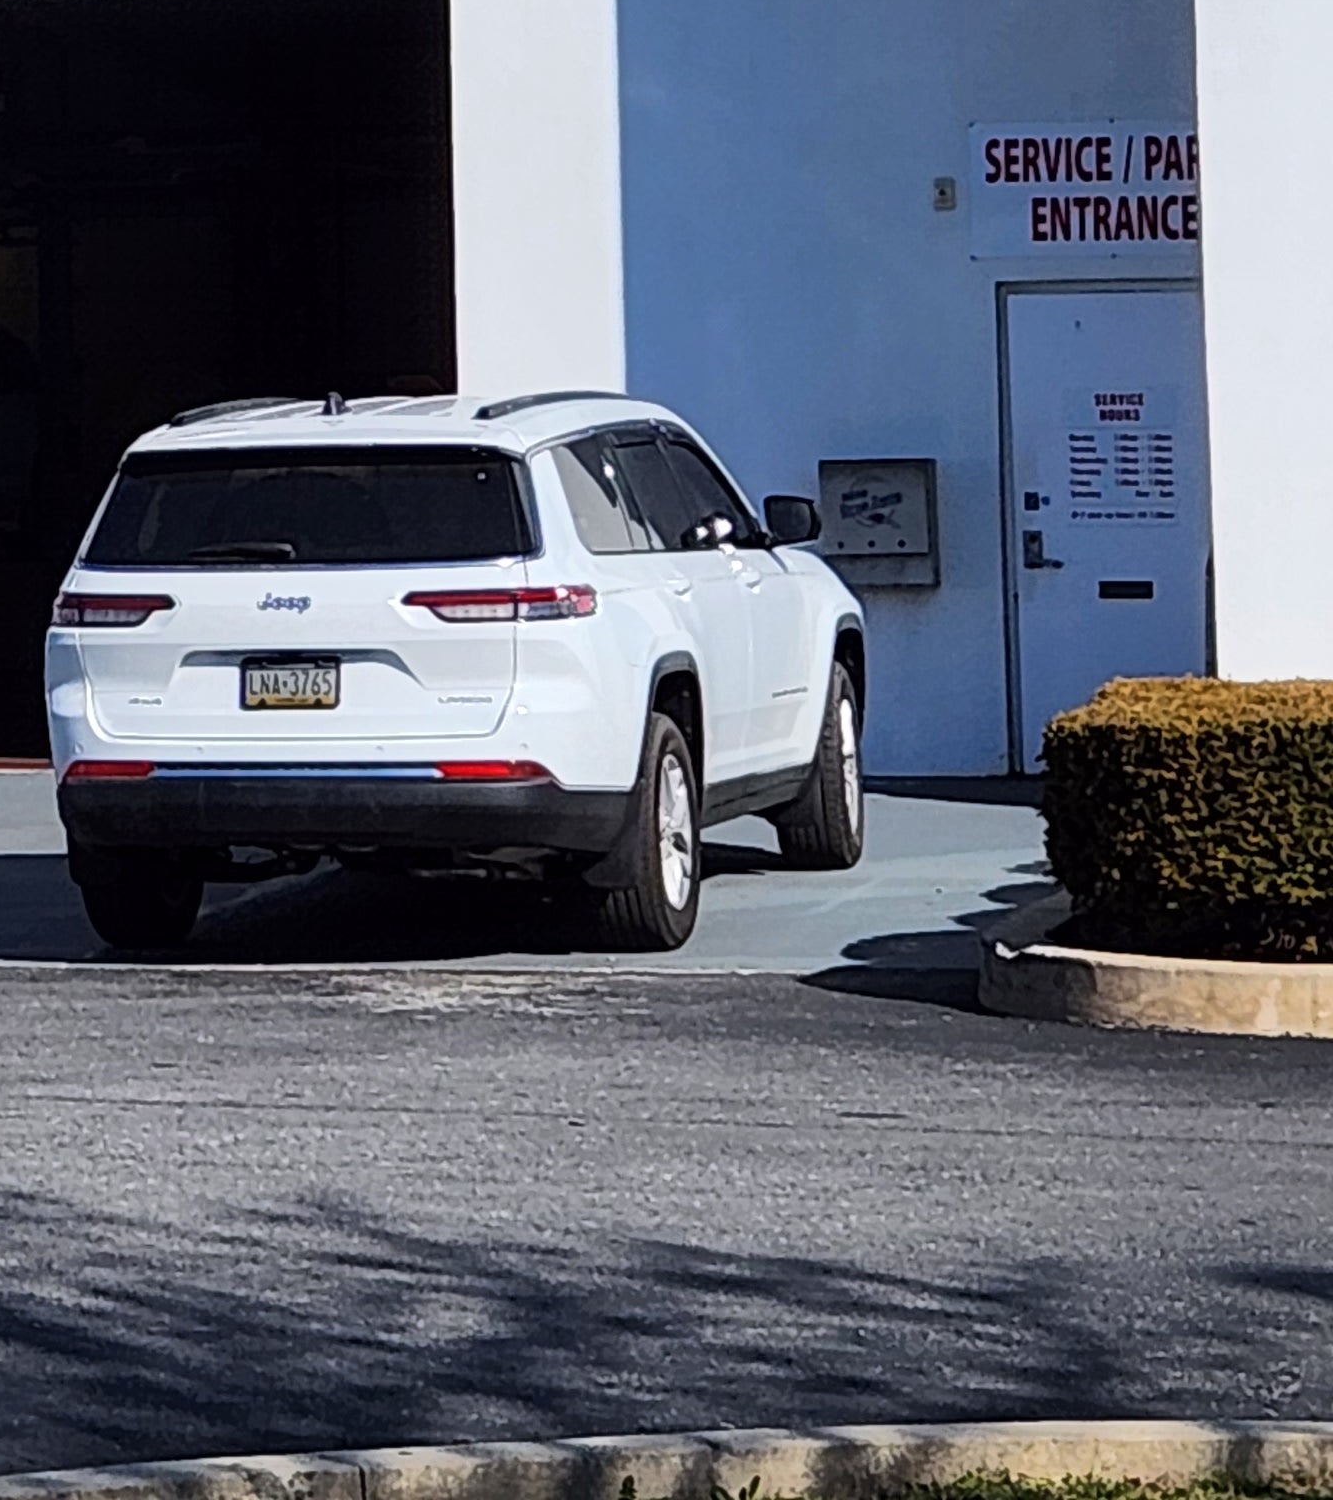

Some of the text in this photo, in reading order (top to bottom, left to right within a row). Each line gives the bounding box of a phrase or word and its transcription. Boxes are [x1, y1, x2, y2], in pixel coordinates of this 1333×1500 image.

[985, 137, 1113, 183] SERVICE
[1122, 136, 1133, 184] /
[1031, 195, 1197, 241] ENTRANCE
[1094, 393, 1144, 407] SERVICE
[256, 592, 311, 615] Jeep
